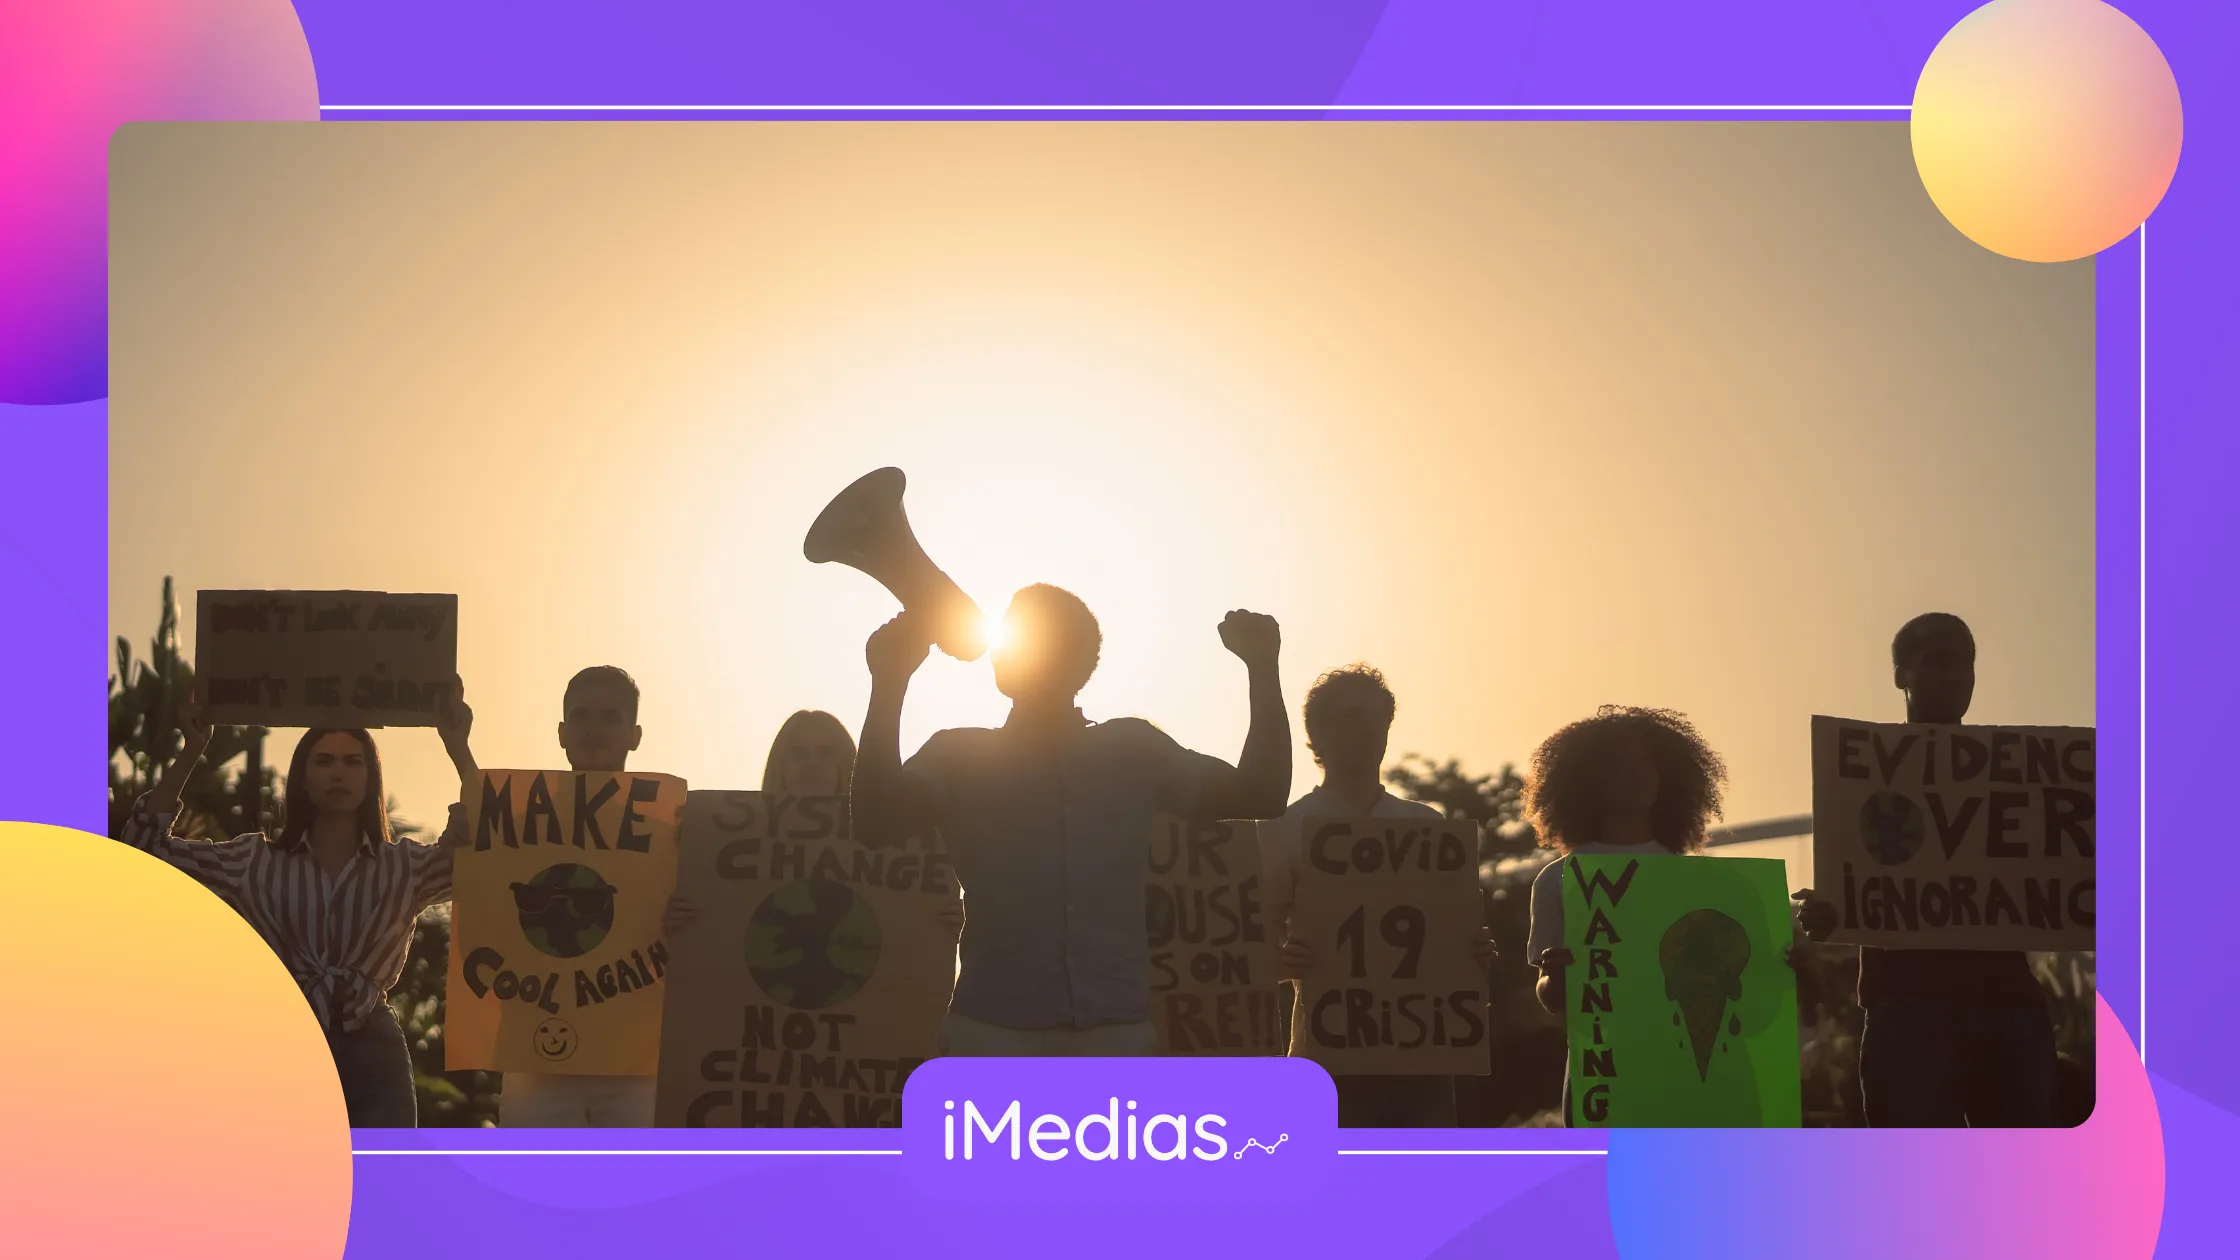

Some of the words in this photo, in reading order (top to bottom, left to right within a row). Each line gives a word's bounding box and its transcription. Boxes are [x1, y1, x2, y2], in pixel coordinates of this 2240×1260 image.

[475, 771, 660, 853] MAKE
[716, 837, 949, 894] CHANGE
[1190, 949, 1251, 985] ON
[1337, 903, 1426, 979] 19
[463, 947, 559, 1014] COOL
[741, 1004, 857, 1051] NOT
